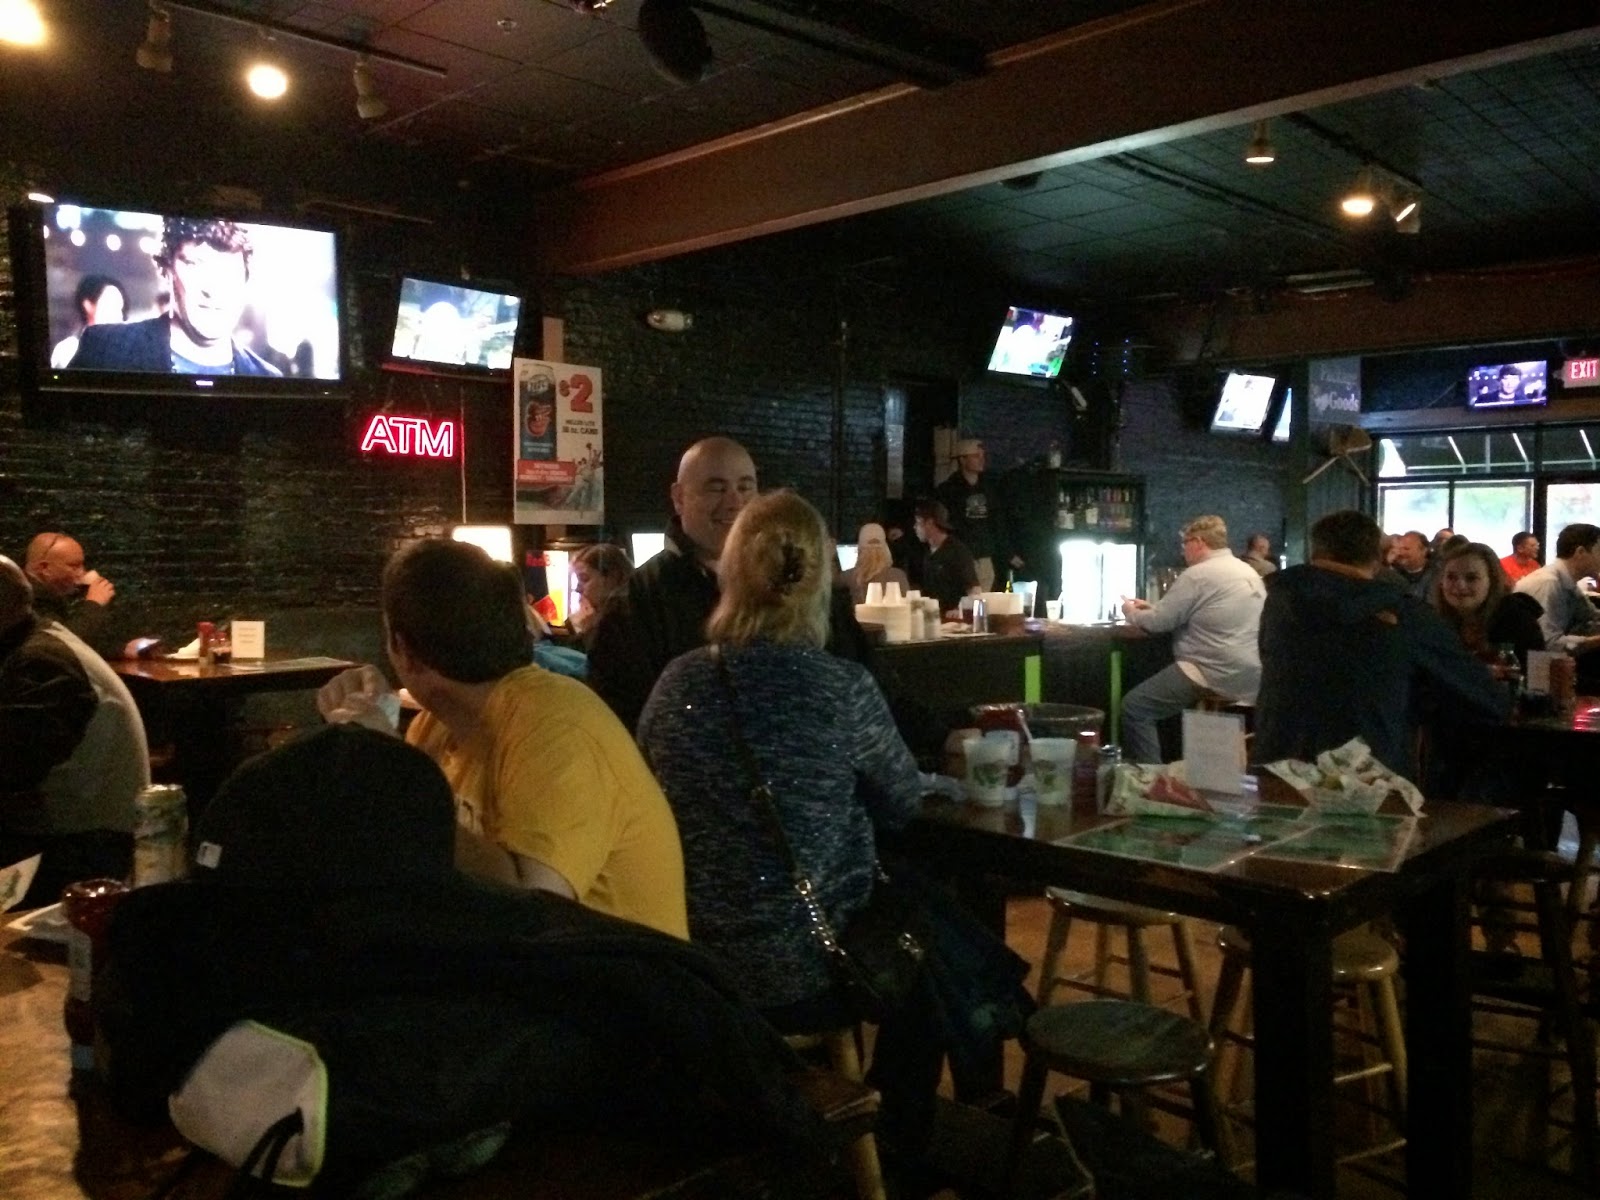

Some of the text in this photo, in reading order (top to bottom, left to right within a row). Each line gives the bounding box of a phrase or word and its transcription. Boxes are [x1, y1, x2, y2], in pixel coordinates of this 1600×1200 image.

[1571, 360, 1598, 379] EXIT
[1330, 391, 1359, 411] Goods
[361, 415, 453, 457] ATM
